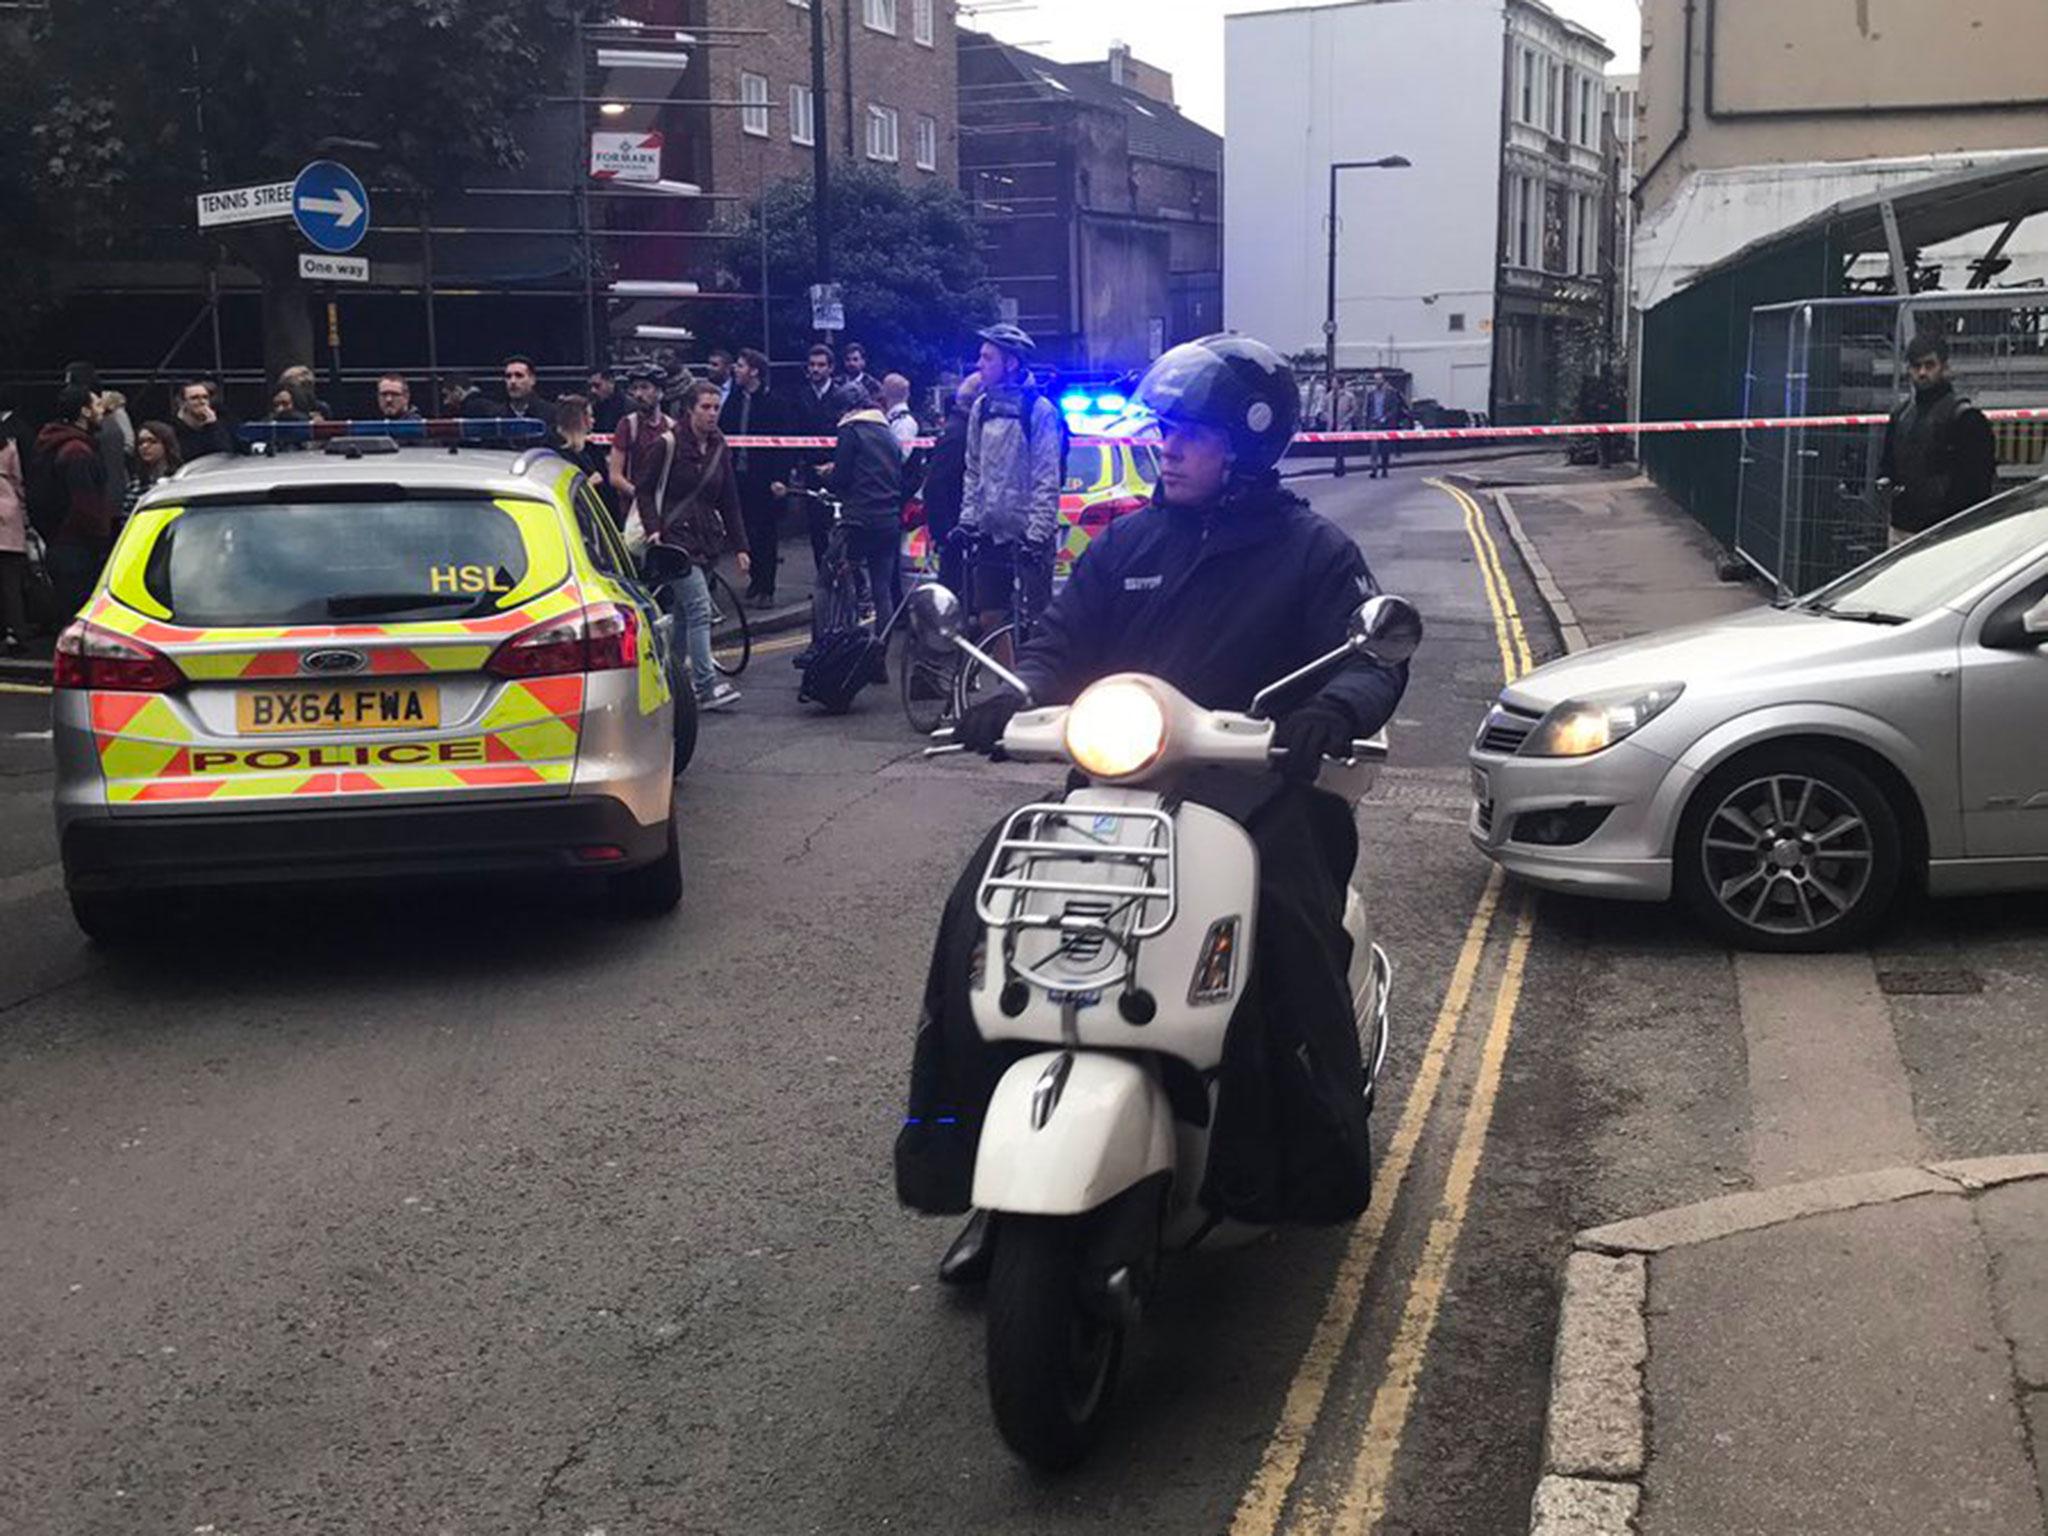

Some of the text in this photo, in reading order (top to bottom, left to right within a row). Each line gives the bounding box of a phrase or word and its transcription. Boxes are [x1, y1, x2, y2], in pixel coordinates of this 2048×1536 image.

[202, 191, 248, 213] TENNIS
[254, 185, 293, 206] STREE
[304, 258, 364, 278] One way
[430, 564, 510, 592] HSL
[253, 690, 423, 724] BX64 FWA
[192, 740, 483, 772] POLICE
